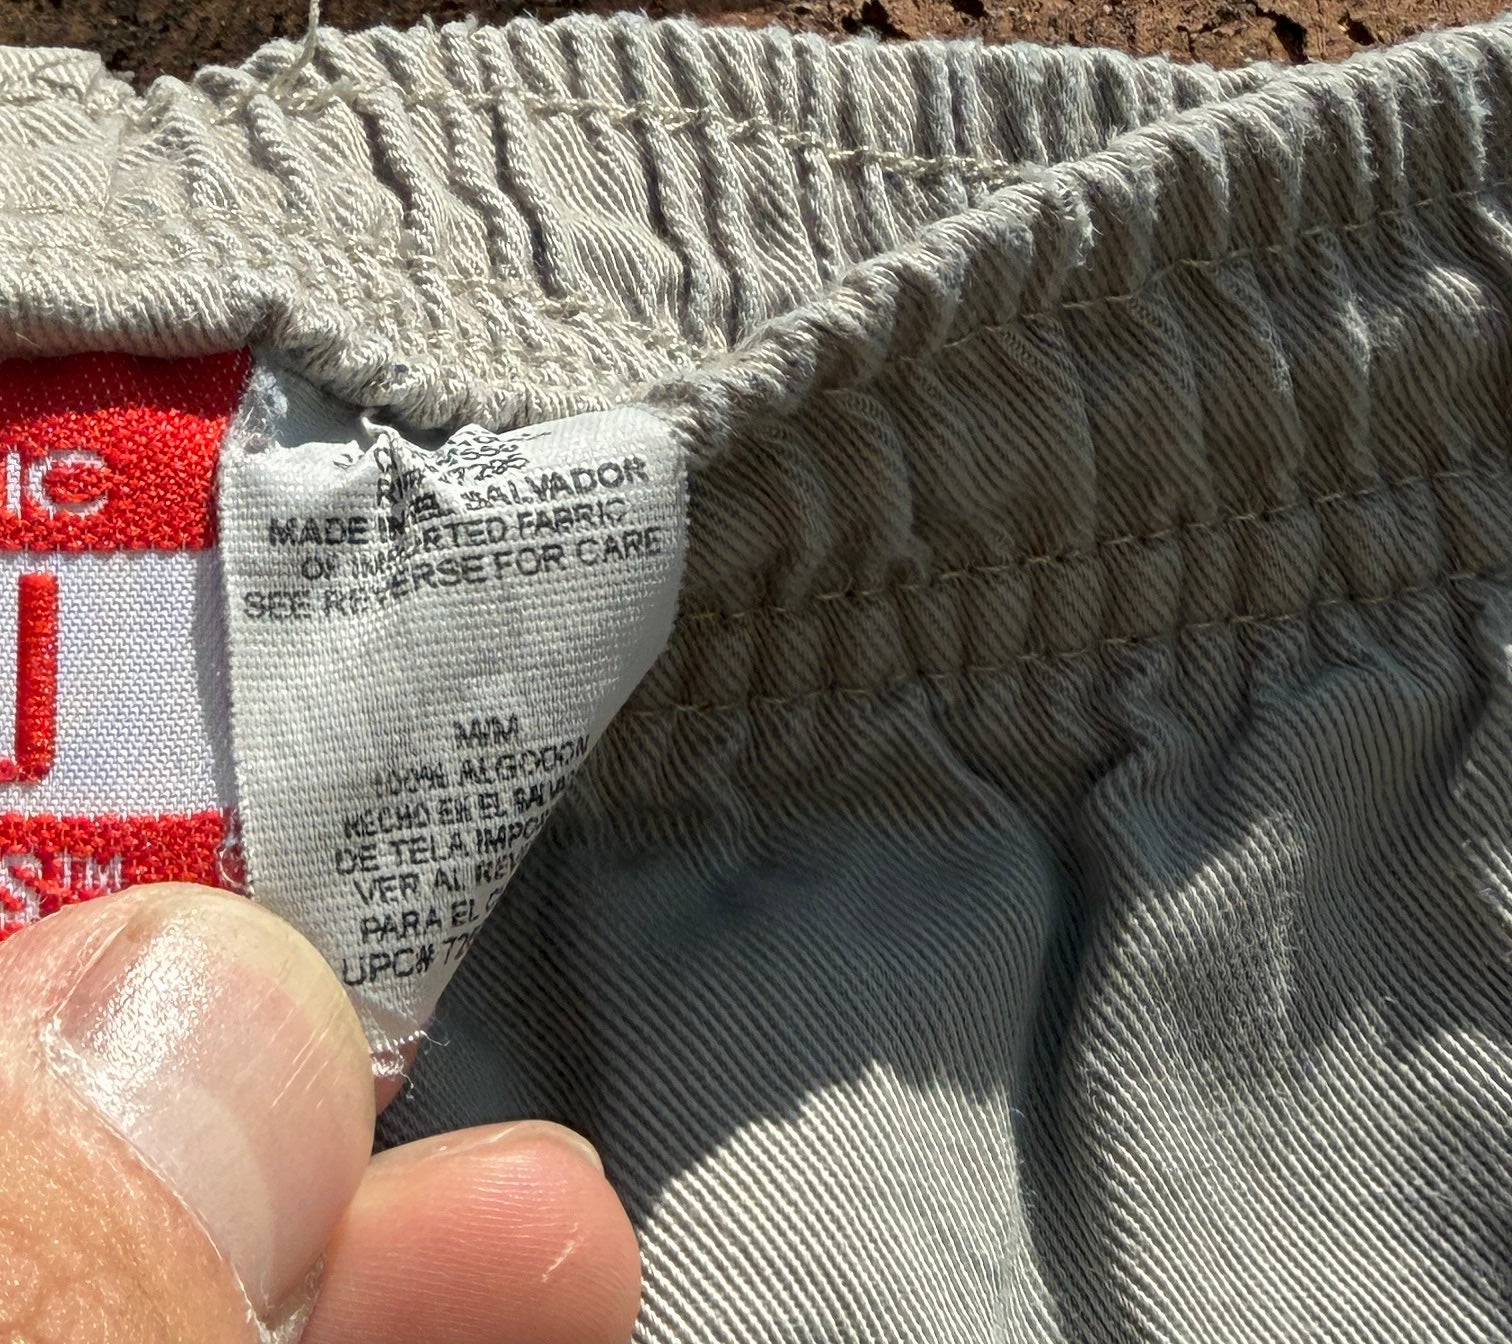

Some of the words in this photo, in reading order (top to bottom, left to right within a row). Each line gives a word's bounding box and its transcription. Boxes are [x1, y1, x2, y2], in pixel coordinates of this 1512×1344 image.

[269, 515, 370, 547] MADE
[460, 455, 651, 512] SALVADOR
[517, 497, 628, 540] FABRIC
[243, 590, 313, 619] SEE
[494, 542, 567, 581] FOR
[576, 526, 664, 567] CARE
[344, 802, 430, 839] HECHO
[438, 796, 472, 825] EN
[478, 789, 508, 820] EL
[336, 841, 380, 875] DE
[388, 832, 470, 866] TELA
[352, 873, 420, 906] VER
[435, 866, 467, 893] AL
[361, 908, 443, 944] PARA
[452, 899, 481, 927] EL
[343, 944, 436, 987] UPC#
